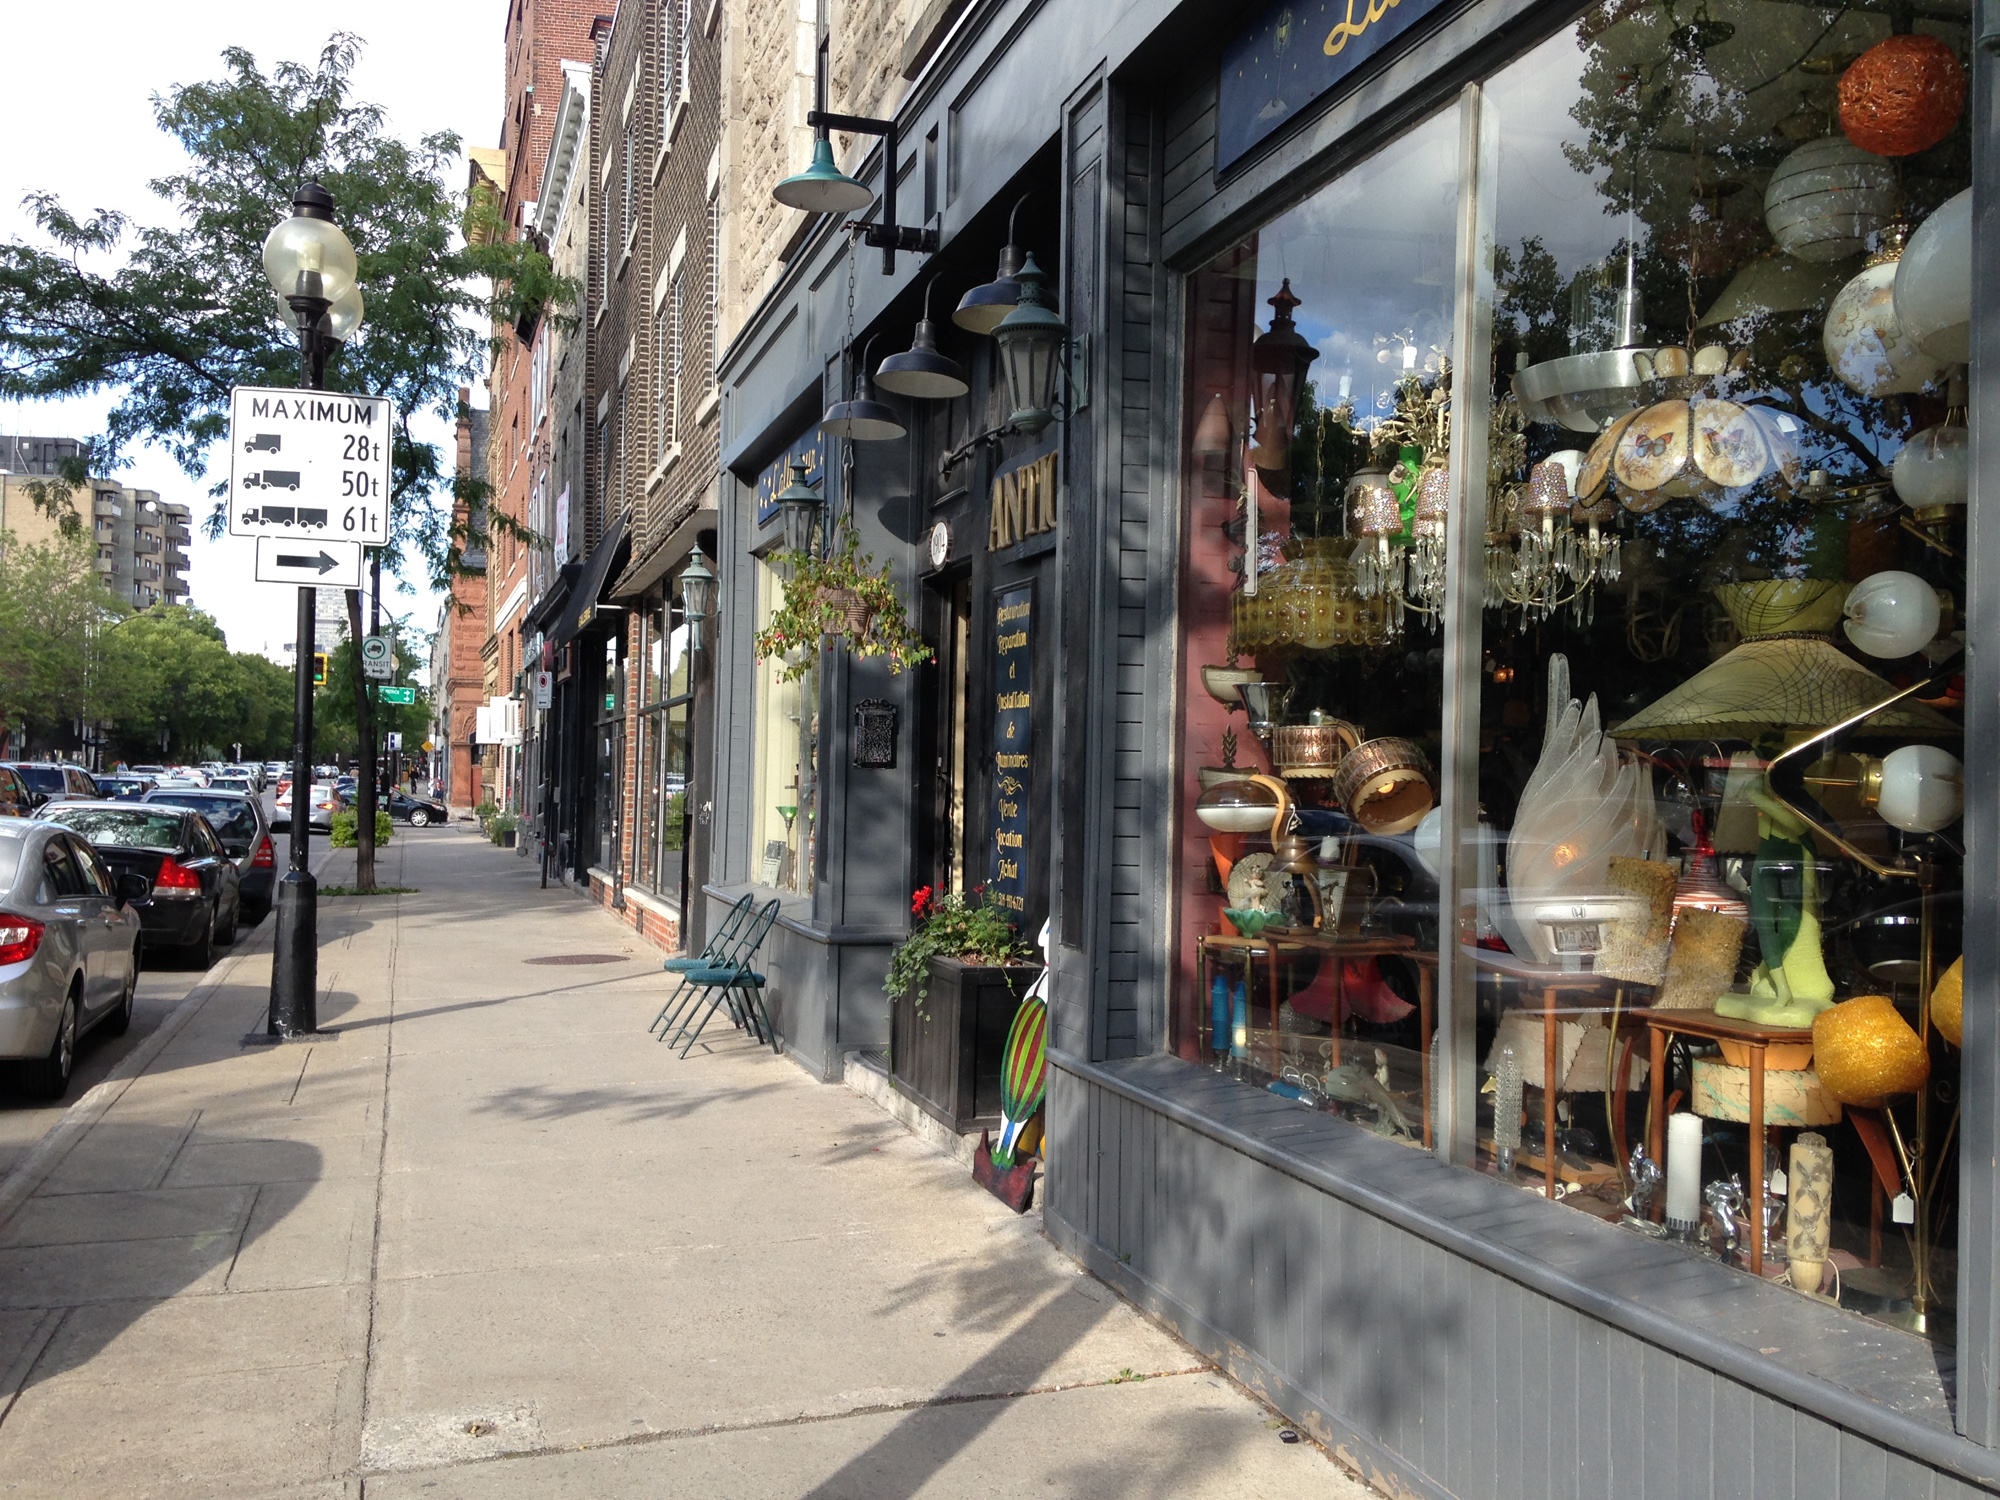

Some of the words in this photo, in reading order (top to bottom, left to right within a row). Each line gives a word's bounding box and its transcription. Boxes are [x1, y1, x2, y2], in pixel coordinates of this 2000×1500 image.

[252, 398, 371, 425] MAXIMUM
[343, 434, 380, 461] 28t
[342, 470, 379, 497] 50t
[343, 506, 378, 532] 61t
[363, 660, 390, 668] RANSIT
[1009, 660, 1016, 680] et
[1006, 721, 1015, 739] de
[995, 751, 1028, 775] Luminaires
[998, 798, 1018, 822] Vente
[995, 827, 1023, 854] Location
[997, 858, 1018, 882] Achat
